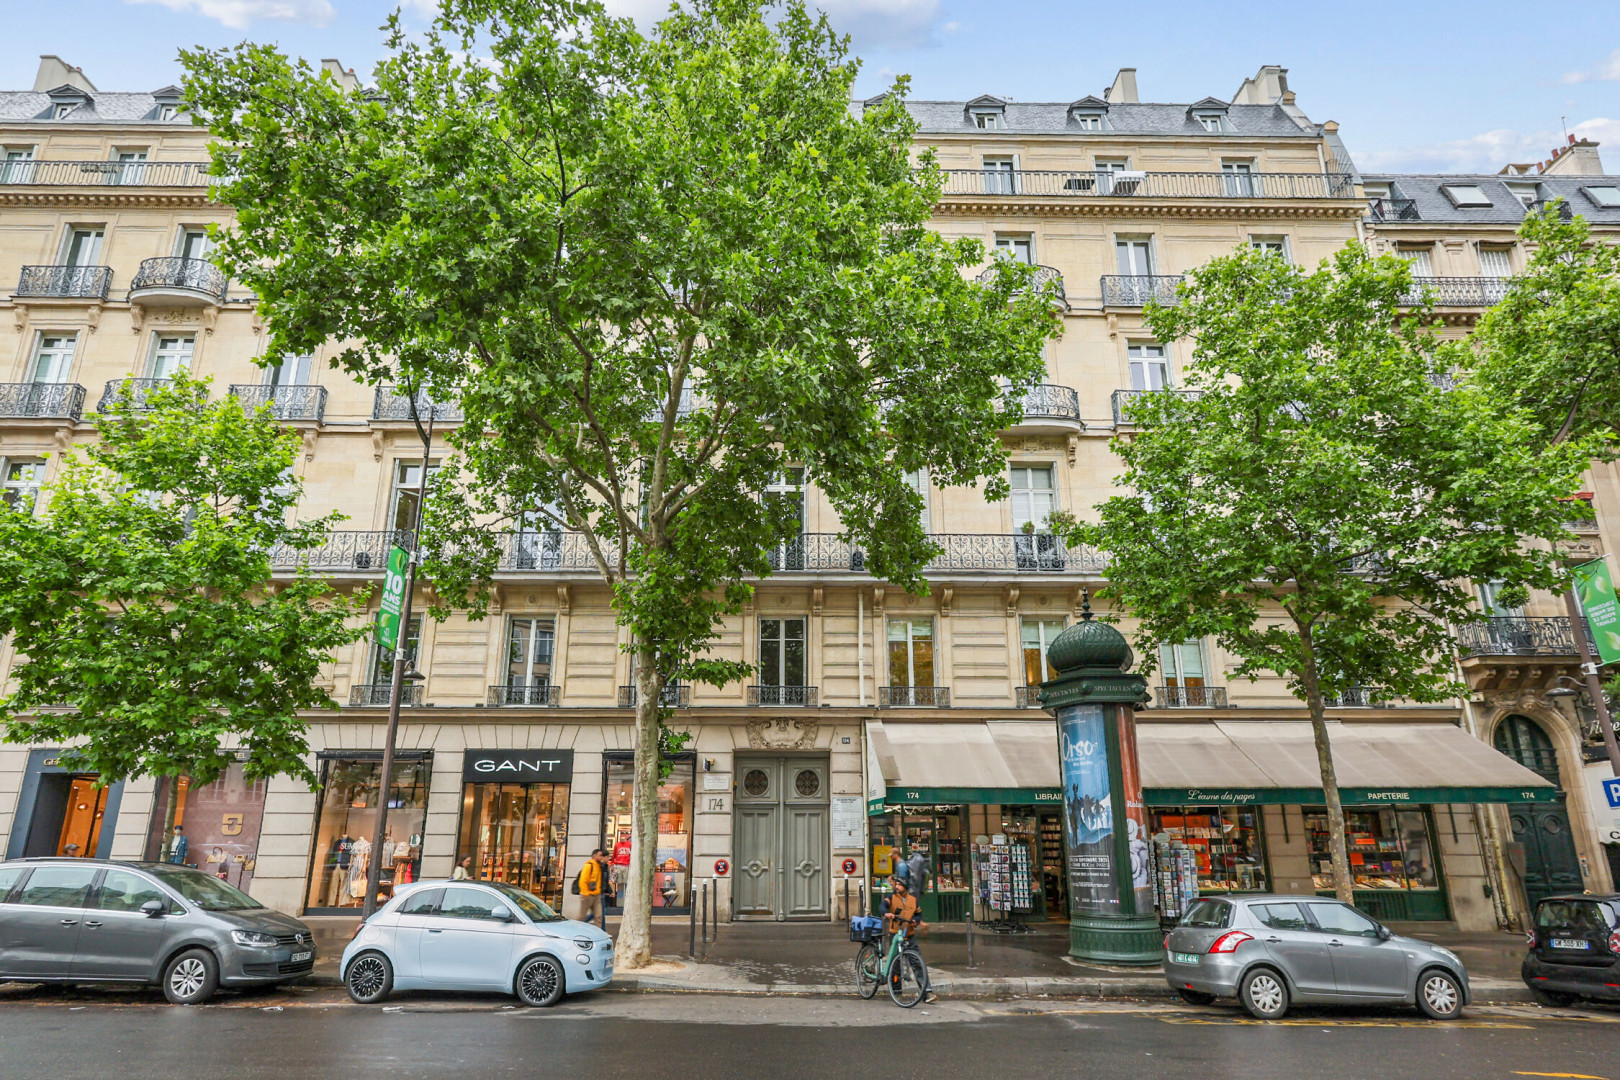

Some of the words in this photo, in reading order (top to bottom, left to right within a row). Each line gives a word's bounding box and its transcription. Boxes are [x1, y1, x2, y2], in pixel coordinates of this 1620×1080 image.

[385, 569, 403, 595] 10
[382, 590, 401, 606] ANS
[1093, 684, 1132, 692] SPECTACLES
[473, 759, 561, 773] GANT
[906, 791, 920, 799] 174
[1220, 790, 1233, 800] des
[1232, 792, 1256, 804] pages
[1367, 791, 1410, 801] PAPETERIE
[1521, 791, 1535, 799] 174
[708, 798, 724, 811] 174
